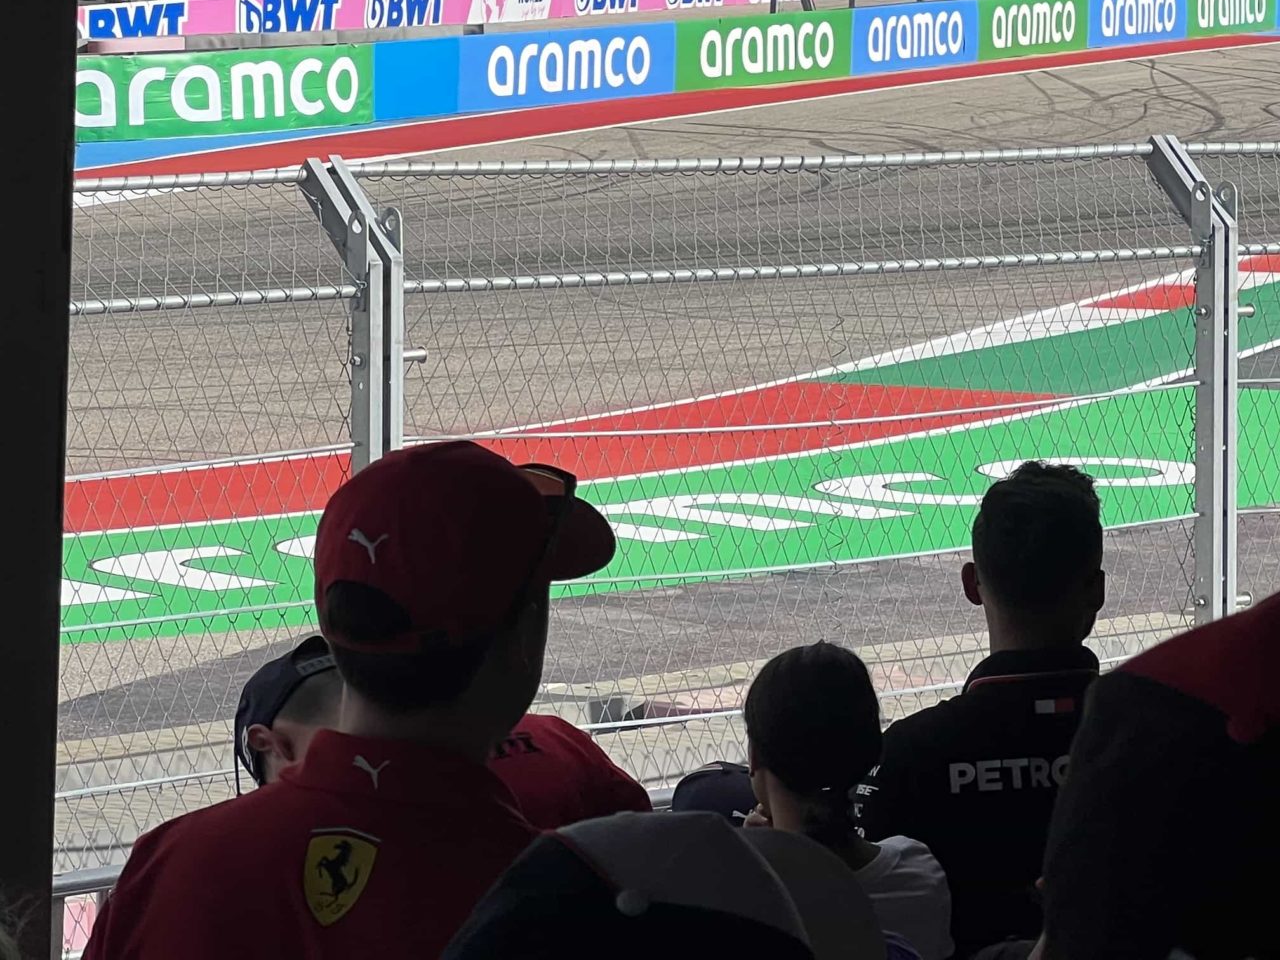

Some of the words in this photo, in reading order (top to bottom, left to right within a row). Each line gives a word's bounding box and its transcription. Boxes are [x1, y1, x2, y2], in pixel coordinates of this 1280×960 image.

[700, 20, 834, 78] aramco
[868, 10, 963, 62] aramco
[992, 0, 1075, 48] aramco
[75, 56, 358, 128] aramco
[487, 35, 651, 97] aramco
